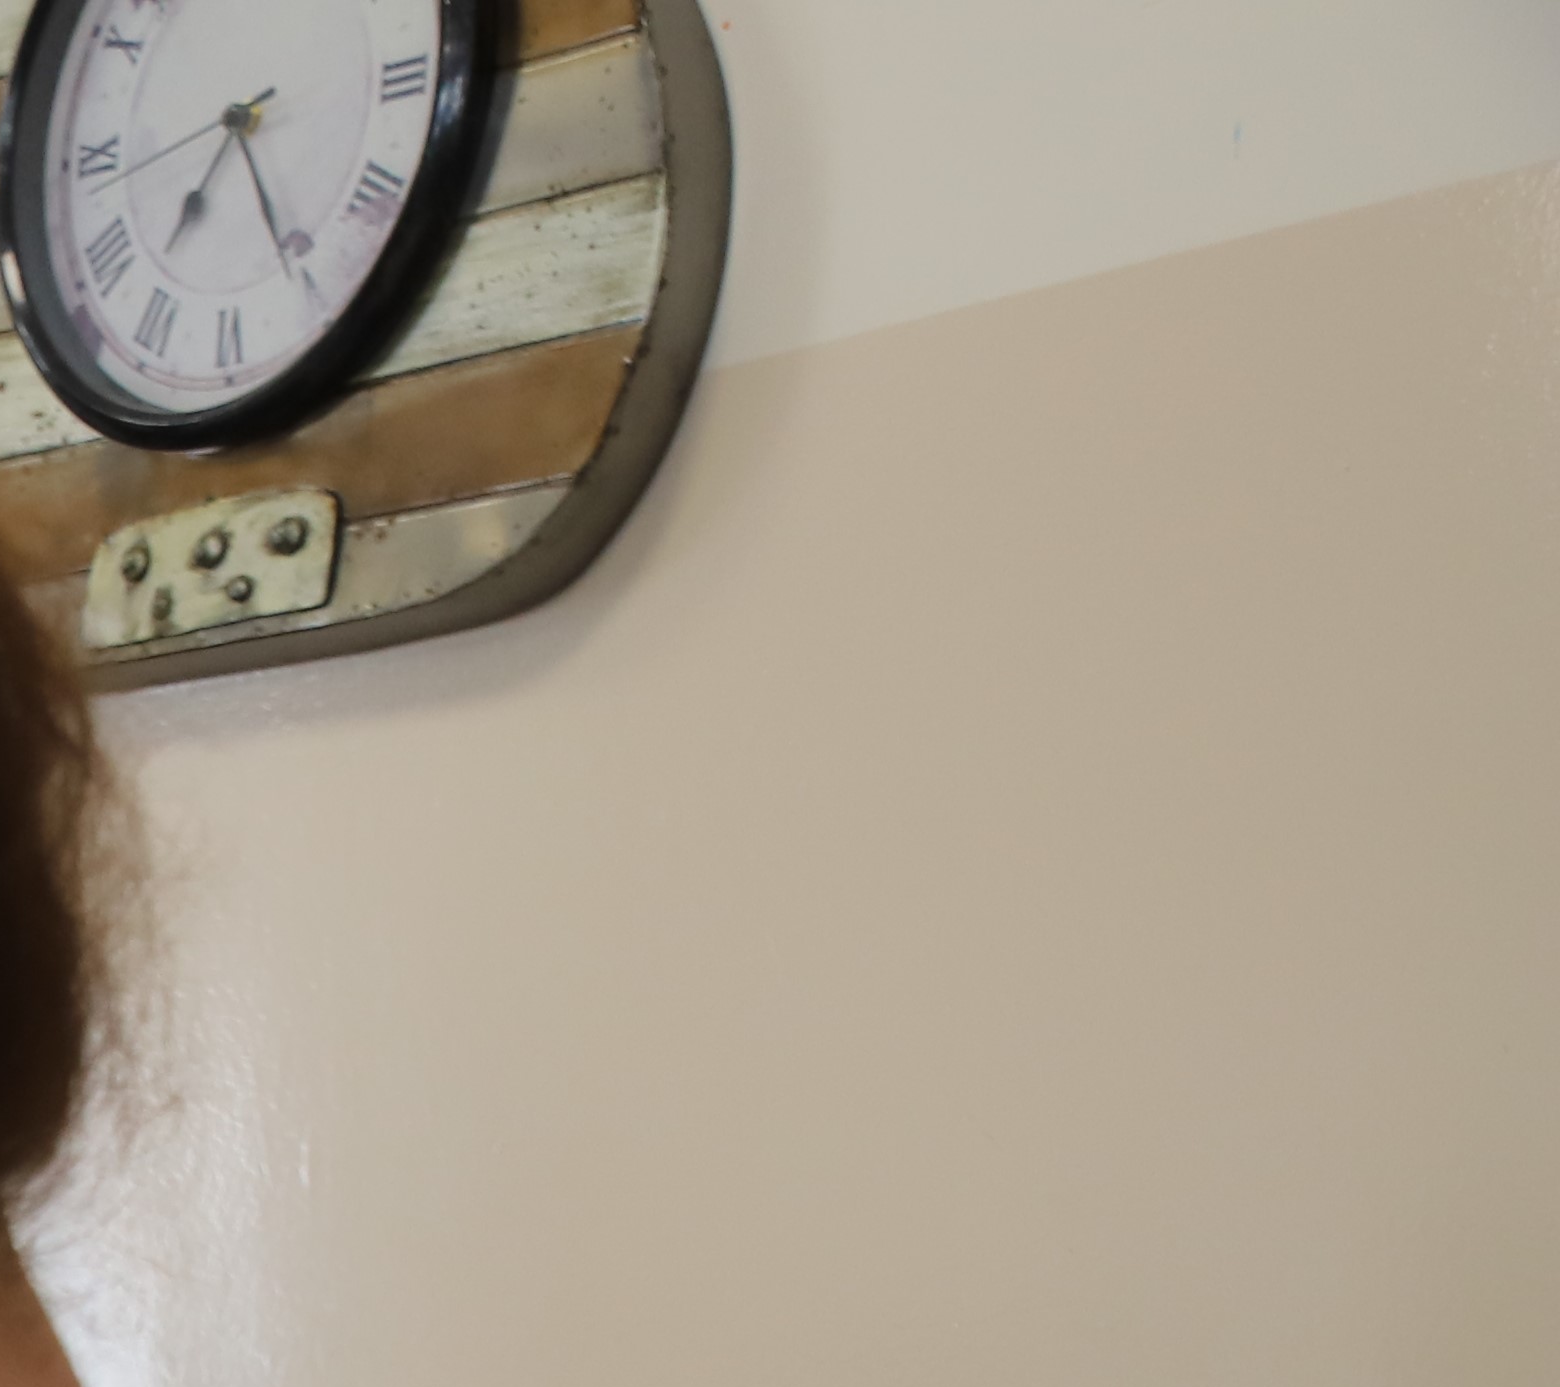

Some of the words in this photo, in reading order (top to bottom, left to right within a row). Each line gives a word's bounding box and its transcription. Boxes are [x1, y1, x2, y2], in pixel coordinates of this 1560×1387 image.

[105, 23, 143, 66] X
[380, 53, 427, 105] III
[78, 133, 119, 179] IX
